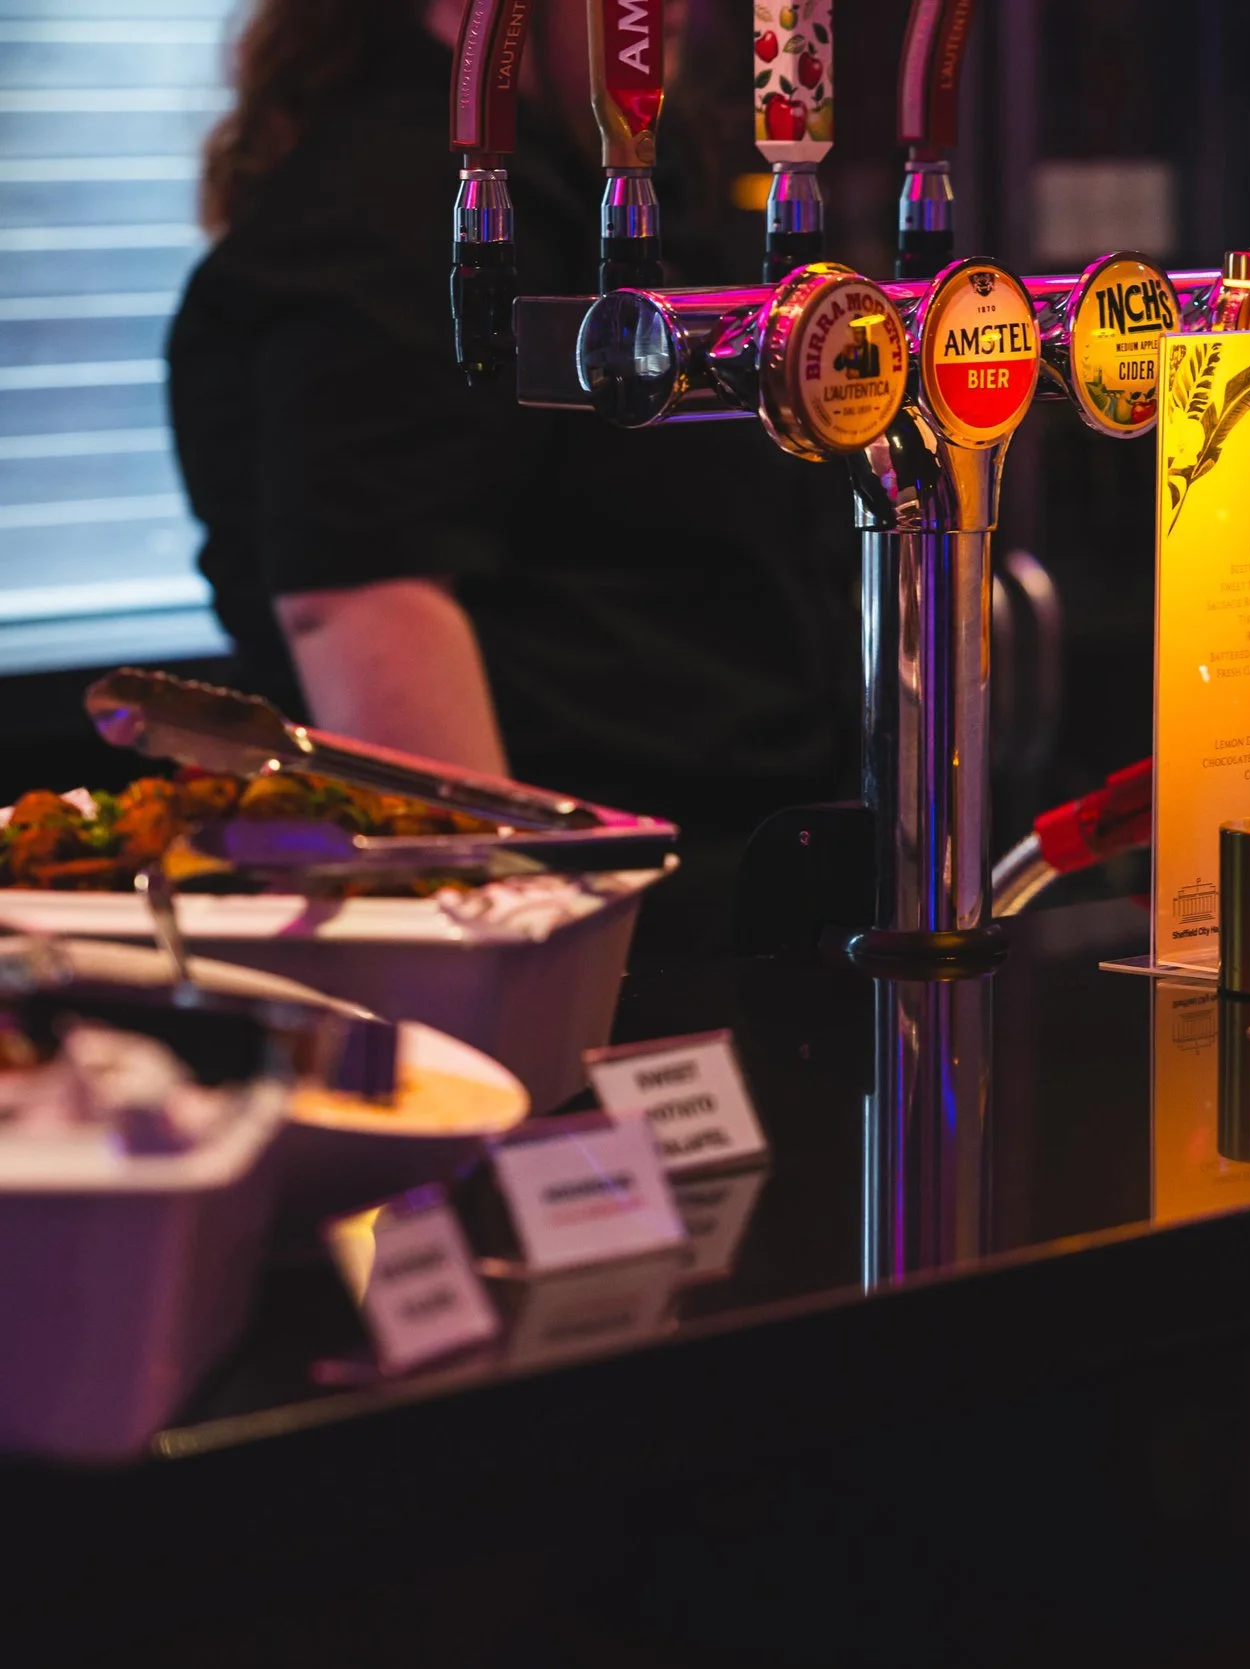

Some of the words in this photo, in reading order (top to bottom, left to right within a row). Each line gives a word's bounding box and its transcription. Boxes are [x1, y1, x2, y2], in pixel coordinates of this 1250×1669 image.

[977, 305, 996, 314] 1870
[1096, 279, 1174, 335] INCH'S
[806, 301, 845, 381] BIRRA
[845, 292, 903, 372] MORETTI
[943, 322, 1032, 357] AMSTEL
[1116, 342, 1138, 352] MEDIUM
[967, 368, 1010, 389] BIER
[1119, 360, 1155, 381] CIDER
[824, 380, 890, 402] L'AUTENTICA
[1210, 649, 1250, 663] BATTERED
[1216, 667, 1241, 679] FRESH
[1215, 737, 1245, 750] LEMON
[1172, 928, 1198, 940] Sheffield
[1198, 927, 1210, 937] City
